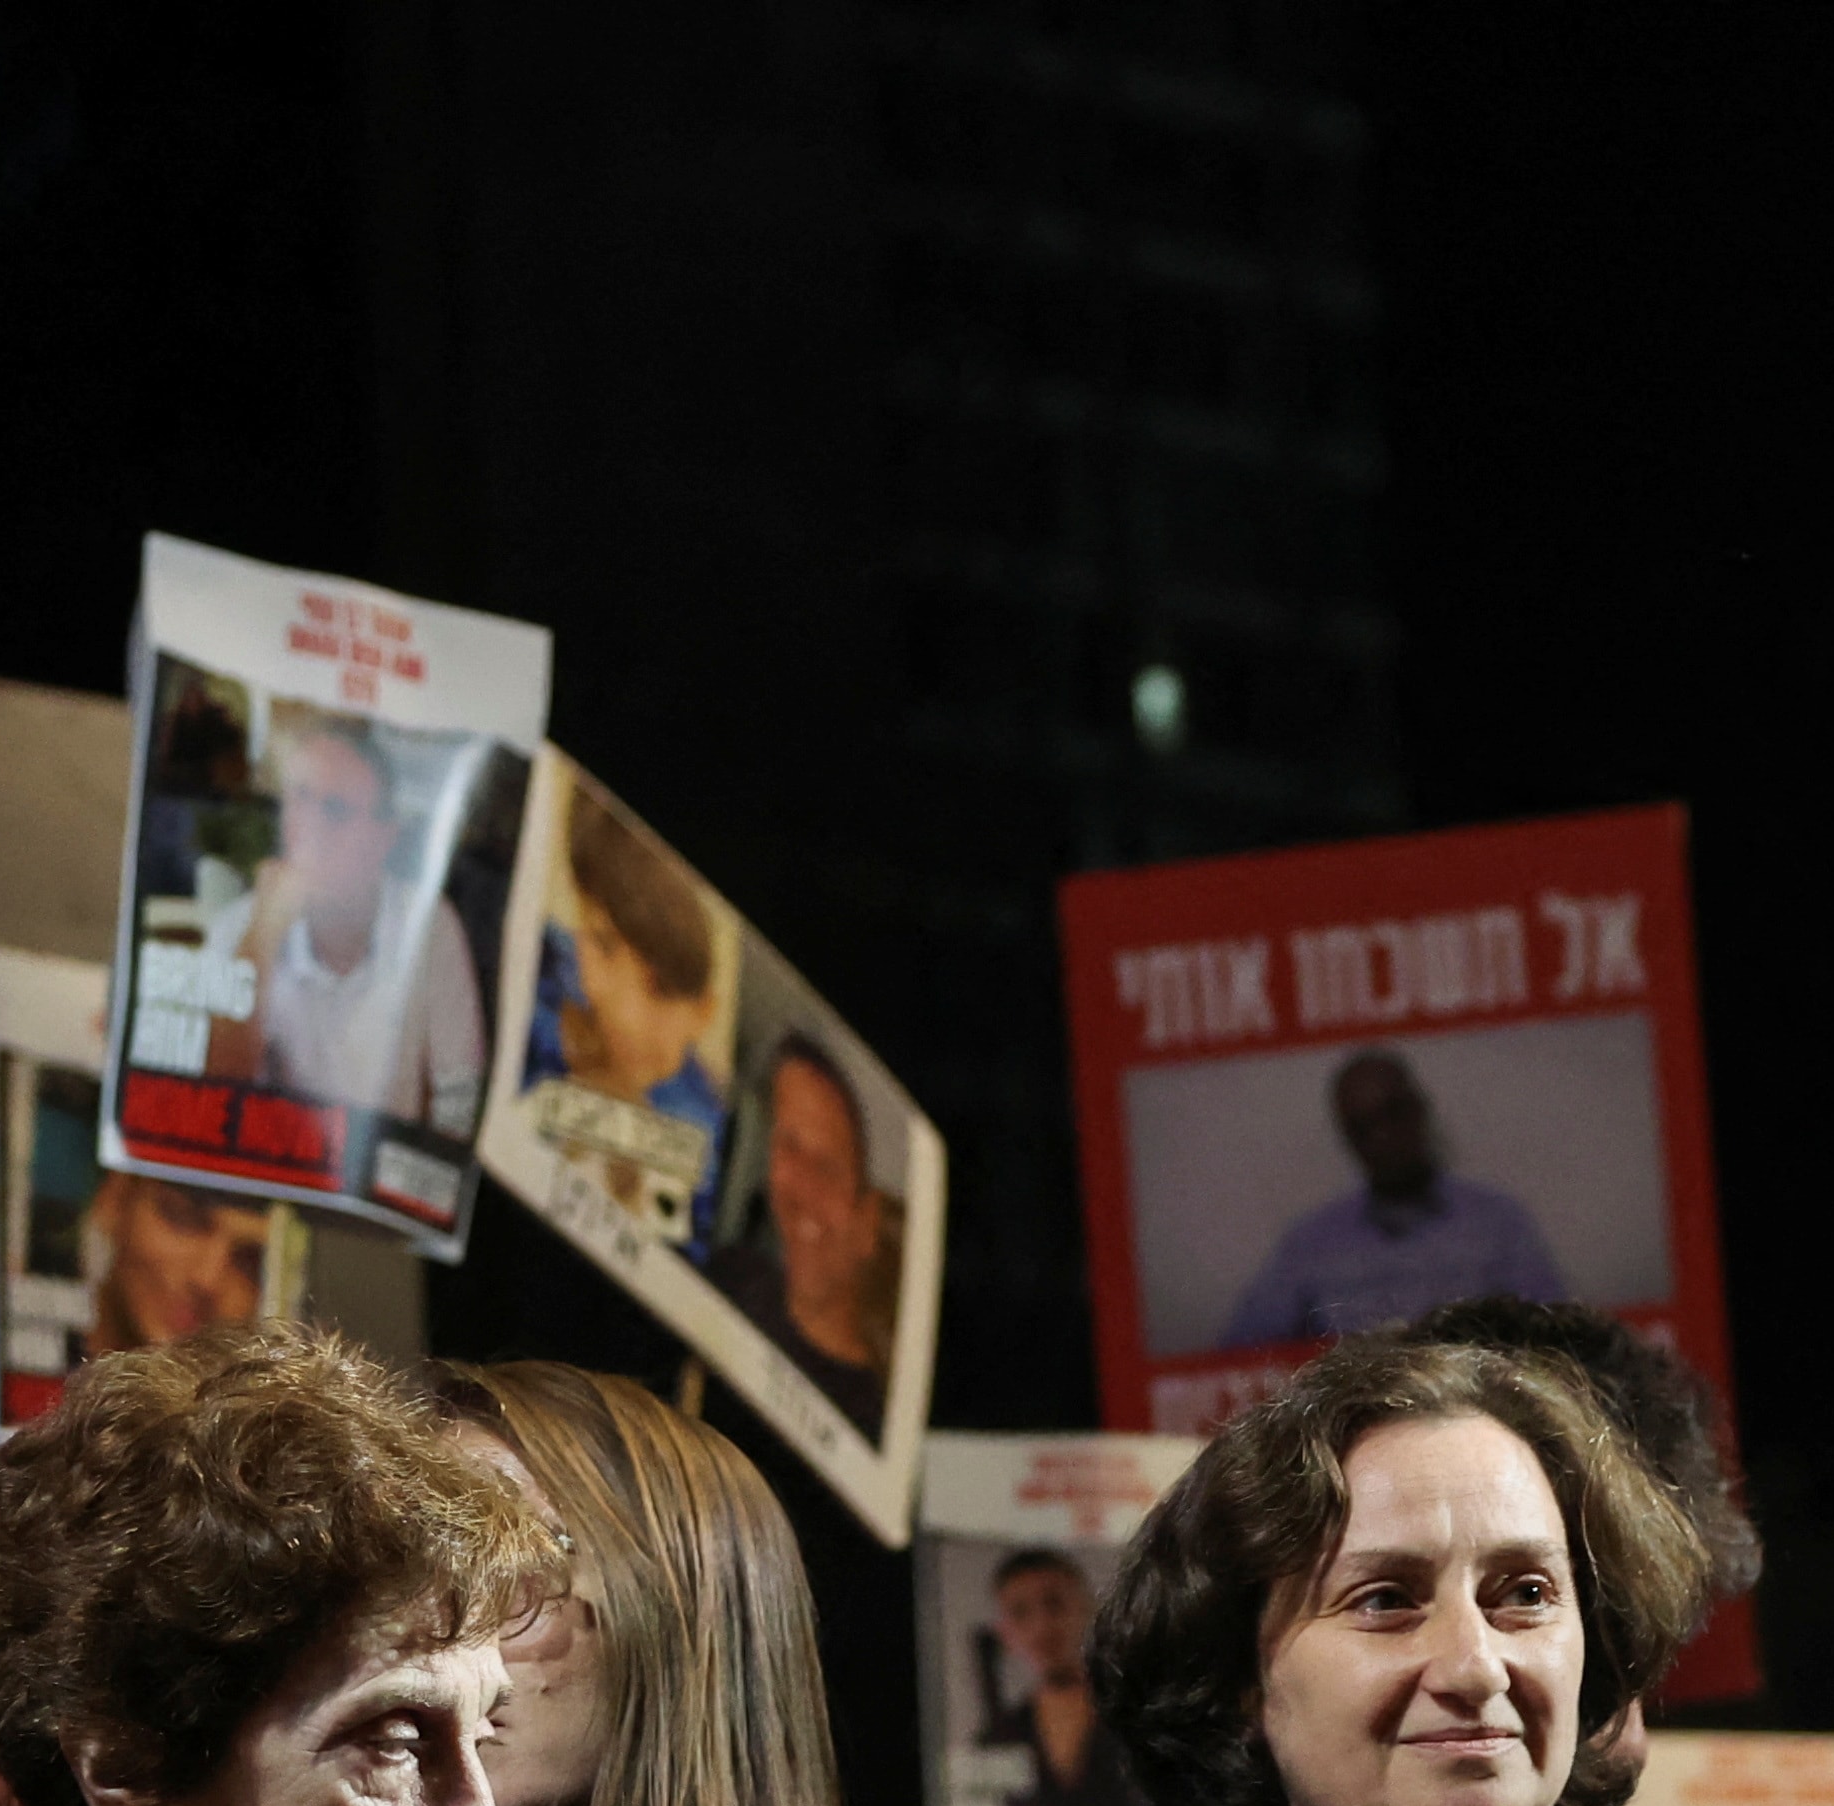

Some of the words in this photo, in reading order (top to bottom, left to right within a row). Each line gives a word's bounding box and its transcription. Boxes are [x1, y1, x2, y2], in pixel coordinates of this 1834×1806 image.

[1114, 936, 1274, 1050] אותי
[1289, 905, 1528, 1029] תשכחו
[1539, 889, 1647, 999] אל
